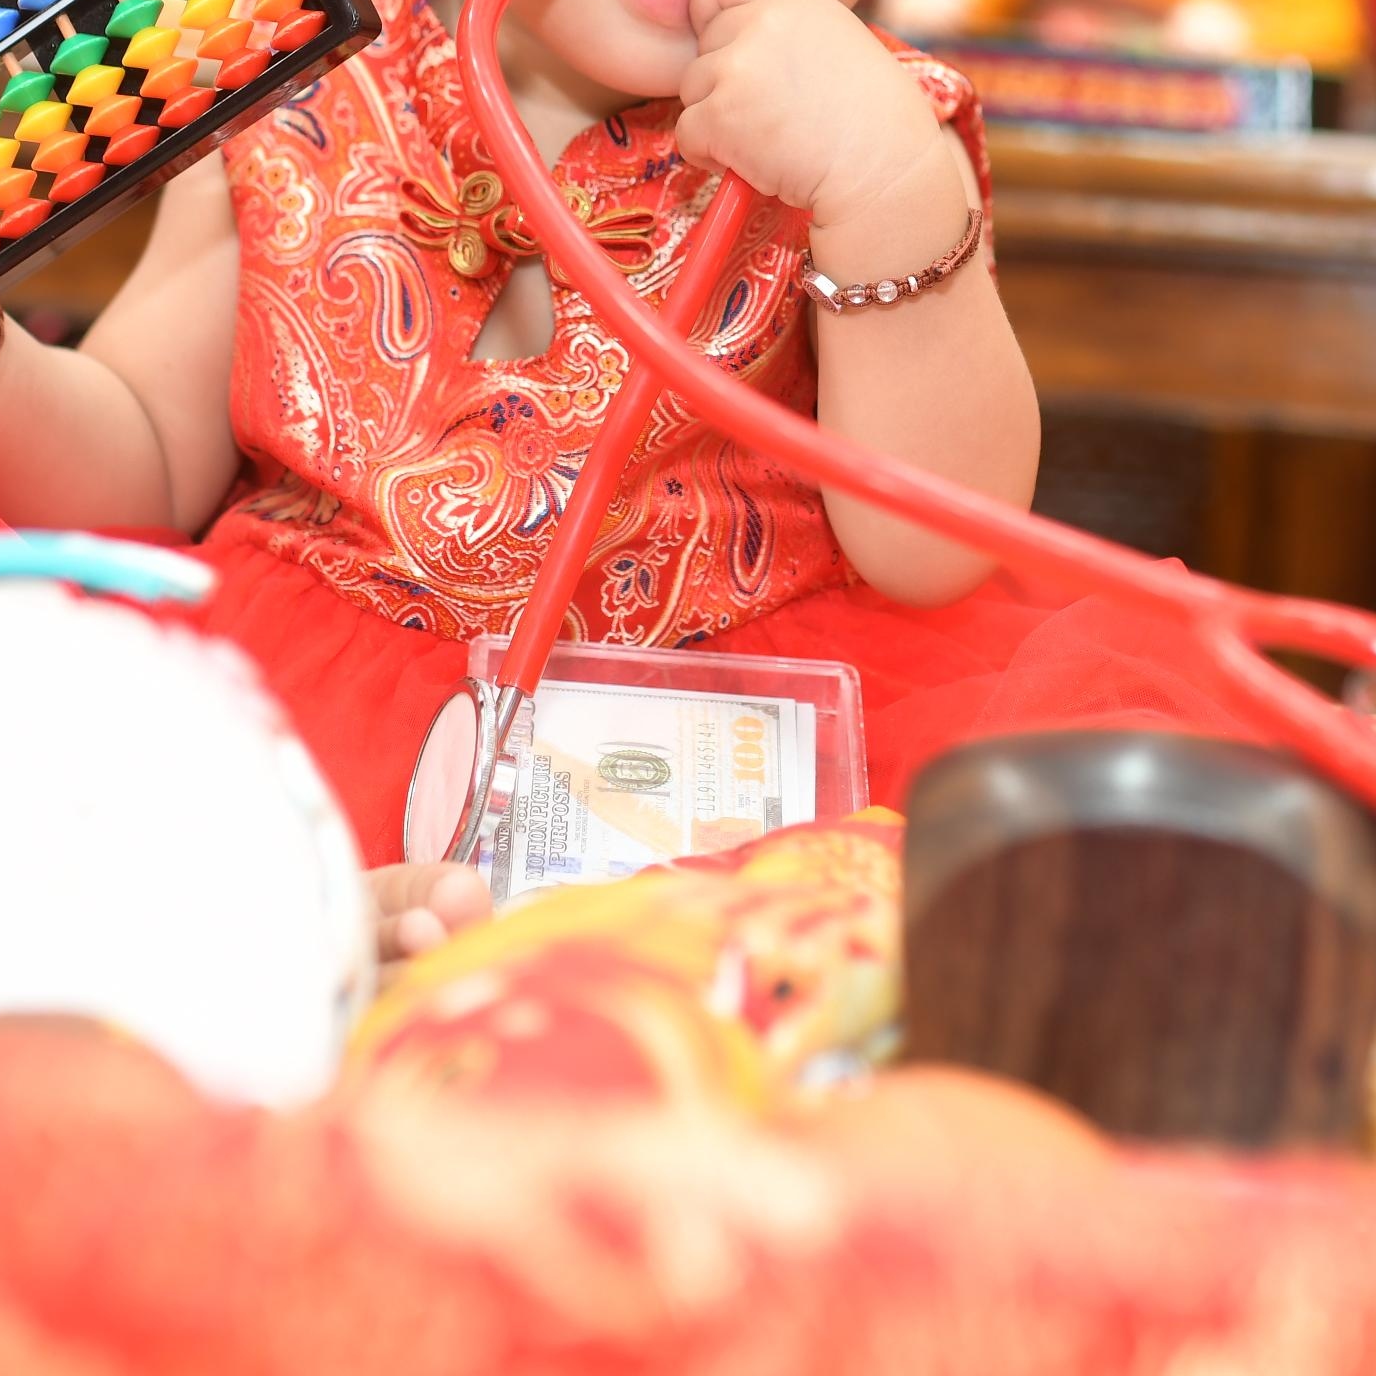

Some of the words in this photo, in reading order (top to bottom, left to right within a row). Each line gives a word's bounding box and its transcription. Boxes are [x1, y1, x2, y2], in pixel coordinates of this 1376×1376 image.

[731, 716, 765, 785] 100
[515, 795, 529, 833] FOR
[530, 754, 552, 817] PICTURE
[498, 828, 510, 850] ONE
[526, 818, 548, 880] MOTION
[549, 771, 571, 866] PURPOSES
